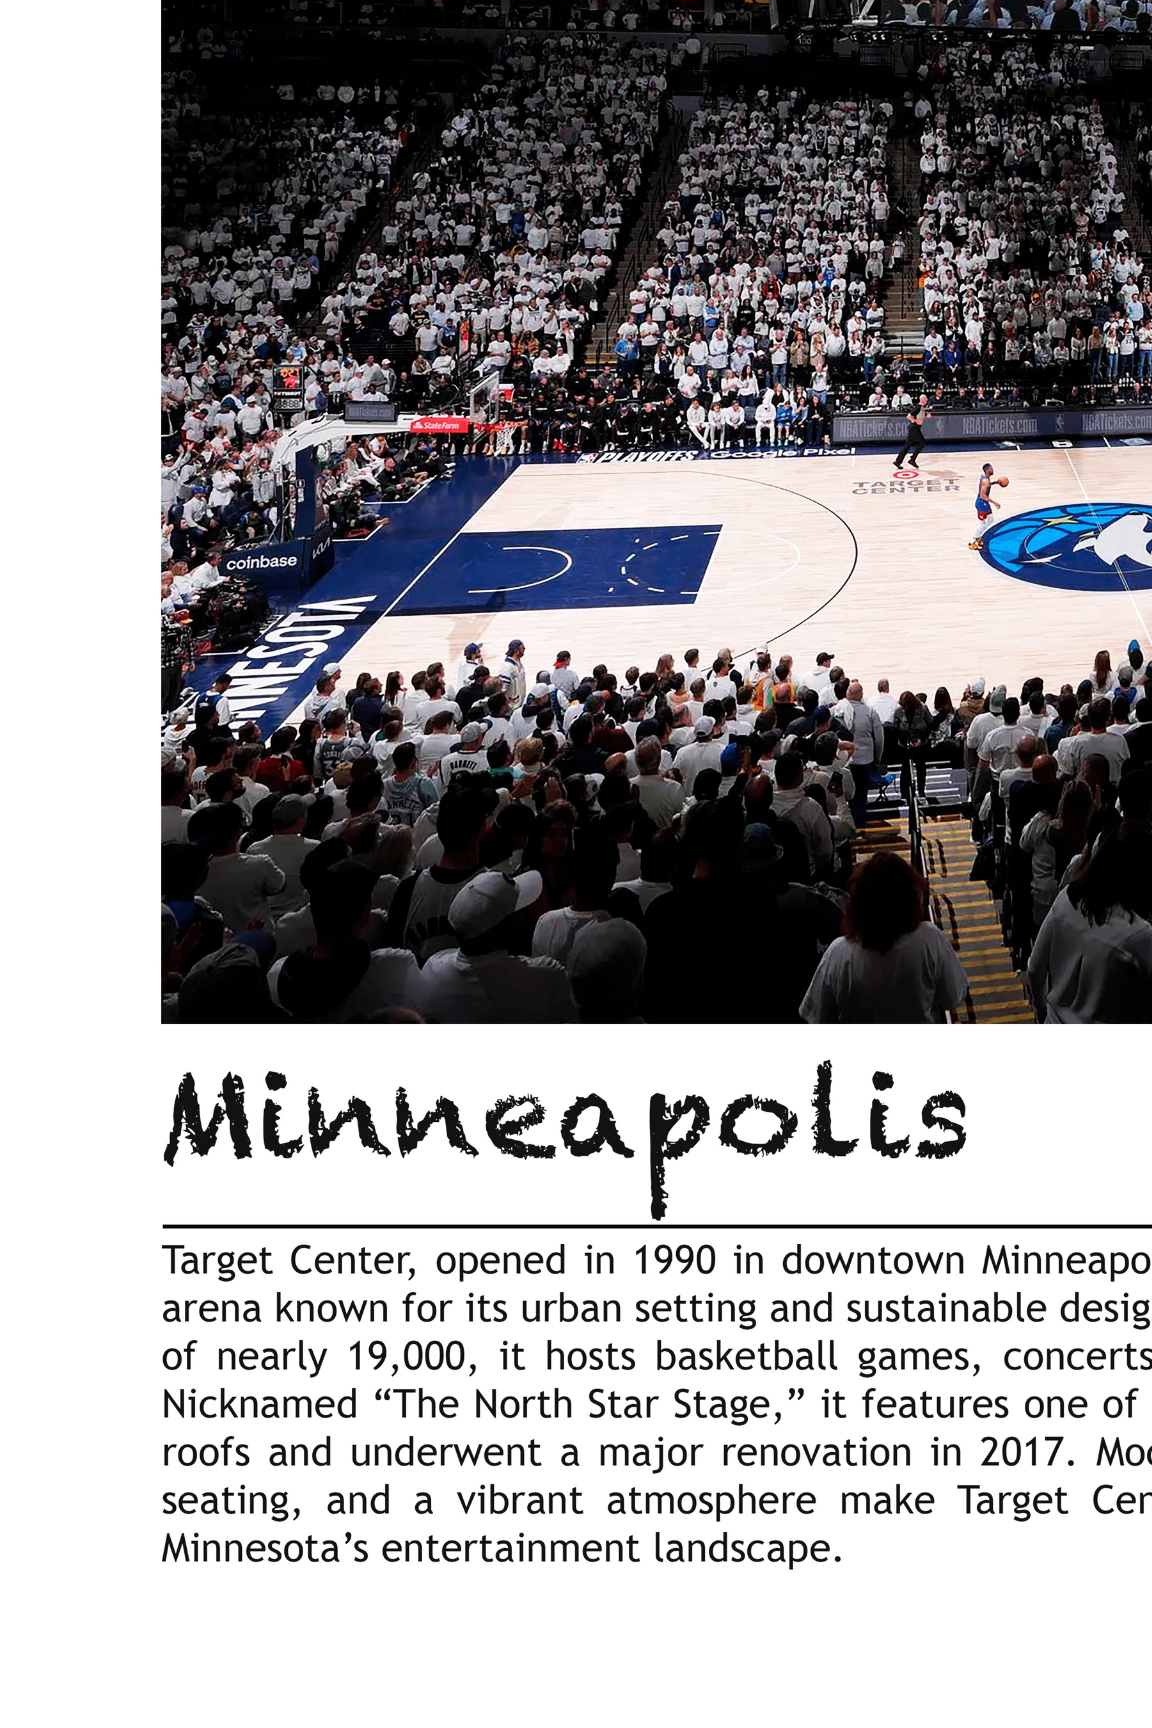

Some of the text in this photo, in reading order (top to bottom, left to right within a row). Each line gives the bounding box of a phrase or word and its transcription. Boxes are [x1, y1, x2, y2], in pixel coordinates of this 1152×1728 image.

[840, 420, 908, 437] NBATickets.co
[962, 417, 1038, 433] NBATickets.com
[600, 451, 698, 462] PLAYOFFS
[711, 447, 856, 460] Google Pixel
[853, 478, 960, 488] TARGET
[852, 485, 960, 495] CENTER
[226, 555, 298, 570] coinbase
